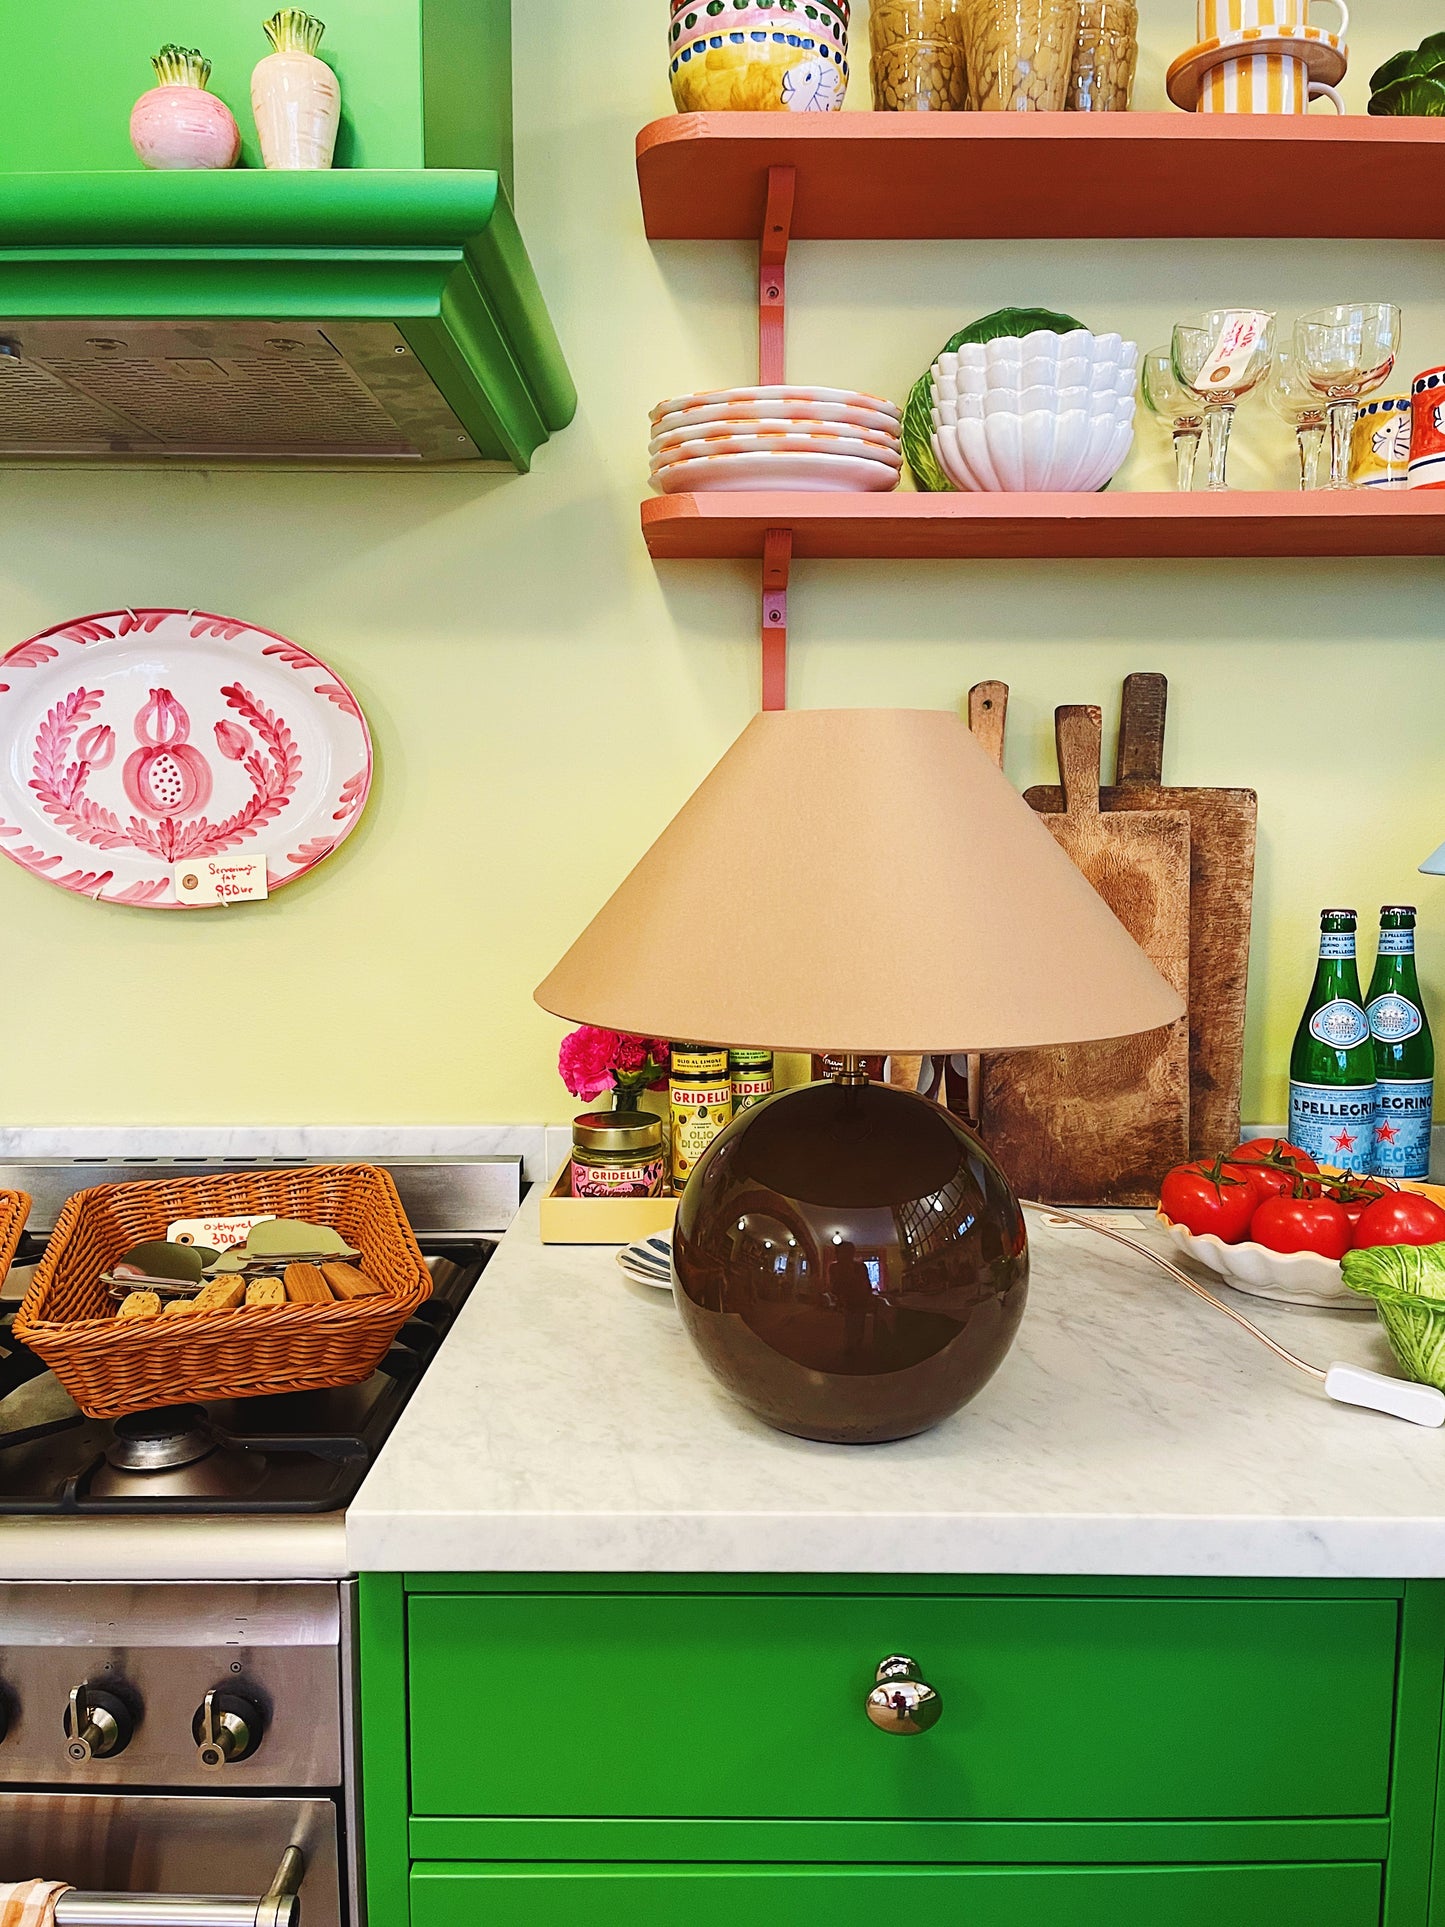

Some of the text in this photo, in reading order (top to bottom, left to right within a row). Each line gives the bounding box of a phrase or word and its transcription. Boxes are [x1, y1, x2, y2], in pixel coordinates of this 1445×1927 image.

[731, 1081, 772, 1094] RIDELLI
[673, 1090, 729, 1104] GRIDELLI
[1376, 1096, 1432, 1110] EGRINO
[689, 1131, 714, 1140] OLIO
[681, 1140, 691, 1149] DI
[592, 1170, 641, 1181] GRIDELLI
[211, 1232, 237, 1245] 300
